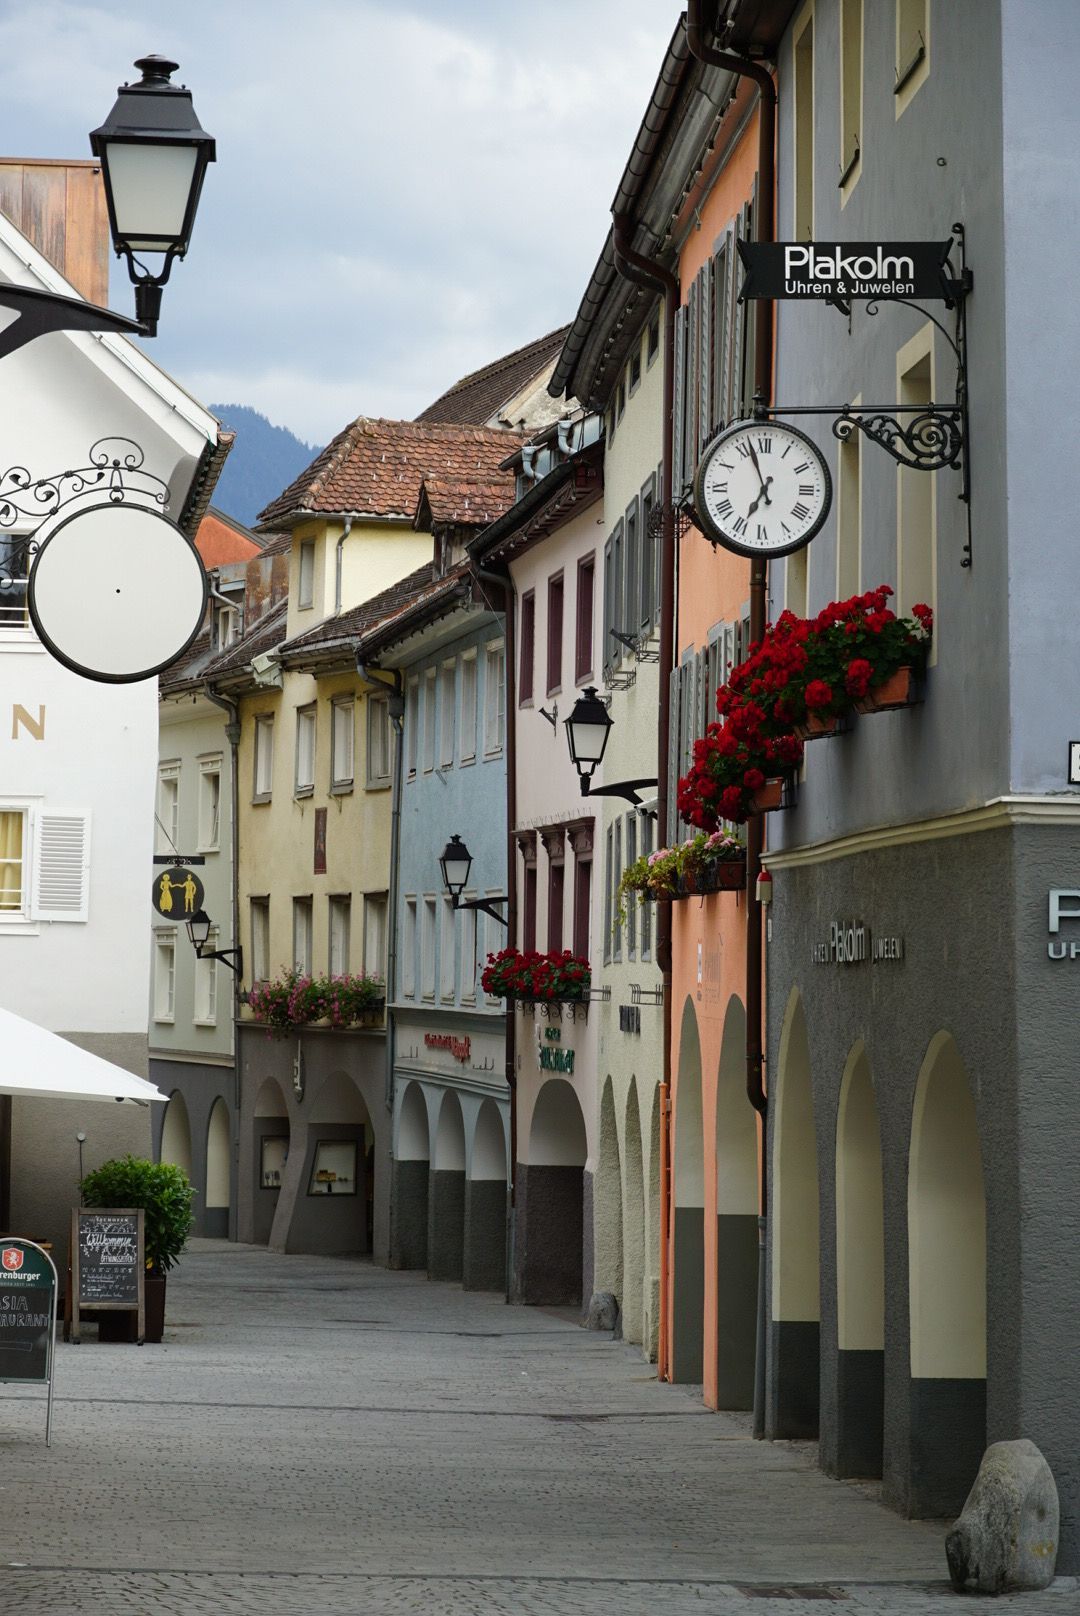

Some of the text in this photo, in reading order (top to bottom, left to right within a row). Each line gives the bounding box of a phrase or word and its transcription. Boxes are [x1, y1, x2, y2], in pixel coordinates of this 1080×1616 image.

[785, 246, 914, 279] Plakolm
[785, 281, 914, 294] Uhren & Juwelen
[758, 438, 772, 453] XII
[12, 704, 45, 740] N
[831, 920, 865, 962] Plakolm
[872, 938, 902, 962] JUWELEN
[0, 1295, 29, 1311] SIA
